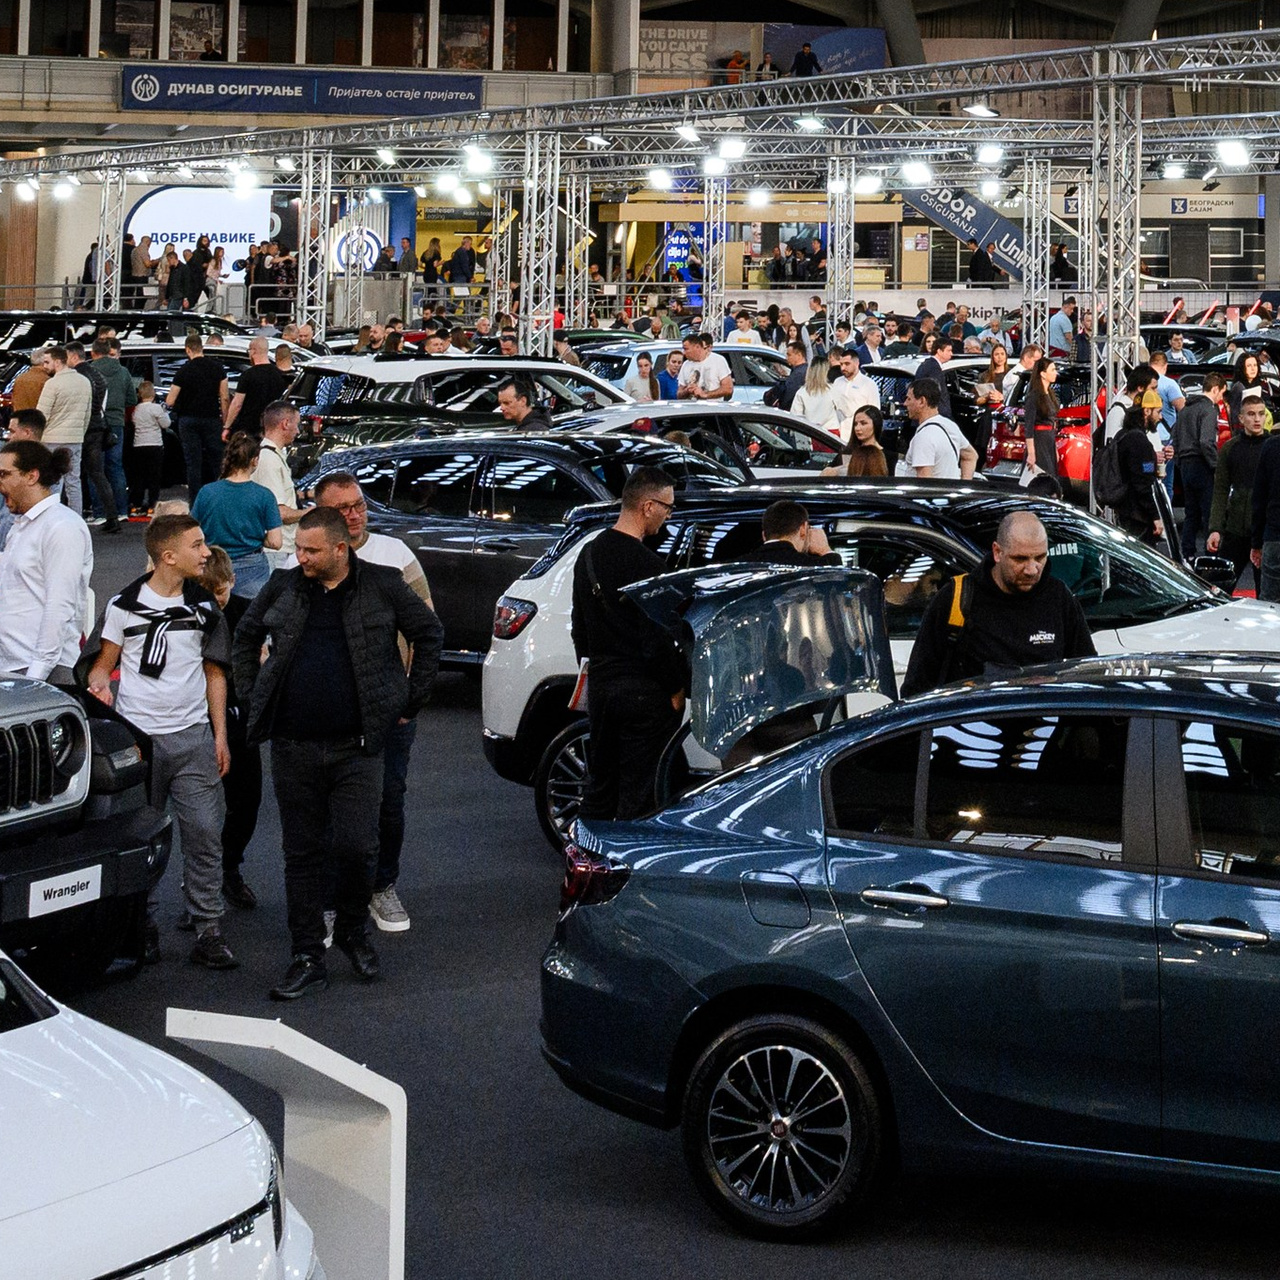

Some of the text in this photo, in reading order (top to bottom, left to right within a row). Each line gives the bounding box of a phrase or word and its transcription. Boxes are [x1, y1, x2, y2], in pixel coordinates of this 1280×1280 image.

[640, 28, 708, 39] THE DRIVE
[640, 40, 708, 52] YOU CAN'T
[640, 52, 708, 69] MISS
[167, 82, 303, 97] ДУНАВ ОСИГУРАЊЕ
[328, 85, 476, 102] Пријатељ остаје пријатељ
[920, 193, 978, 237] OSIGURANJE
[150, 232, 256, 245] ДОБРЕ АВИКЕ
[43, 880, 91, 902] Wrangler
